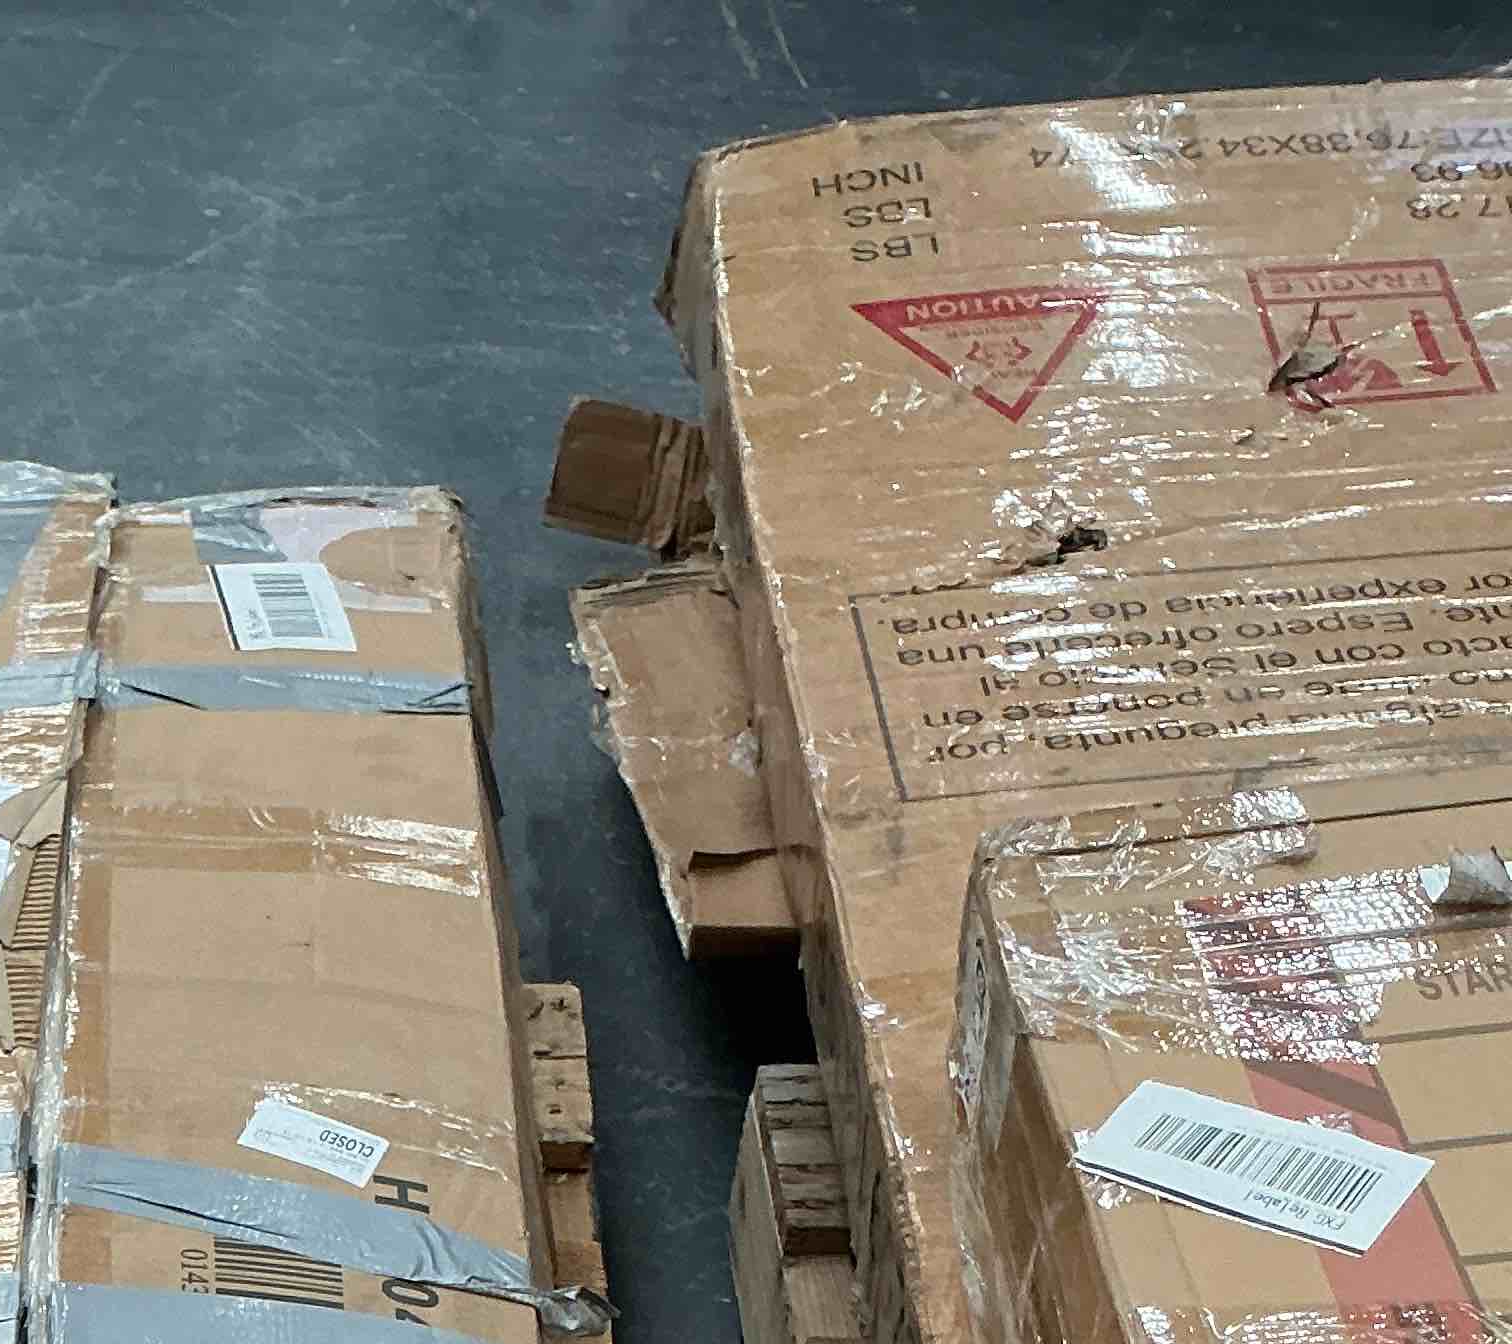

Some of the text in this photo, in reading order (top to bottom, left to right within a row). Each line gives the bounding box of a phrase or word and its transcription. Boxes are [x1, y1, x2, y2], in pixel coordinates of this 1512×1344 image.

[812, 161, 924, 196] INCH
[843, 197, 931, 226] LBS
[850, 235, 940, 262] LBS
[1271, 267, 1433, 293] FRAGILE
[1089, 600, 1147, 622] de
[1235, 611, 1414, 640] Espero
[896, 644, 986, 666] una
[1004, 625, 1217, 661] ofrecerle
[1314, 642, 1405, 665] con
[1254, 651, 1297, 673] el
[1002, 686, 1203, 722] ponerse
[923, 709, 984, 729] en
[927, 734, 1008, 764] por
[319, 1128, 376, 1158] CLOSED
